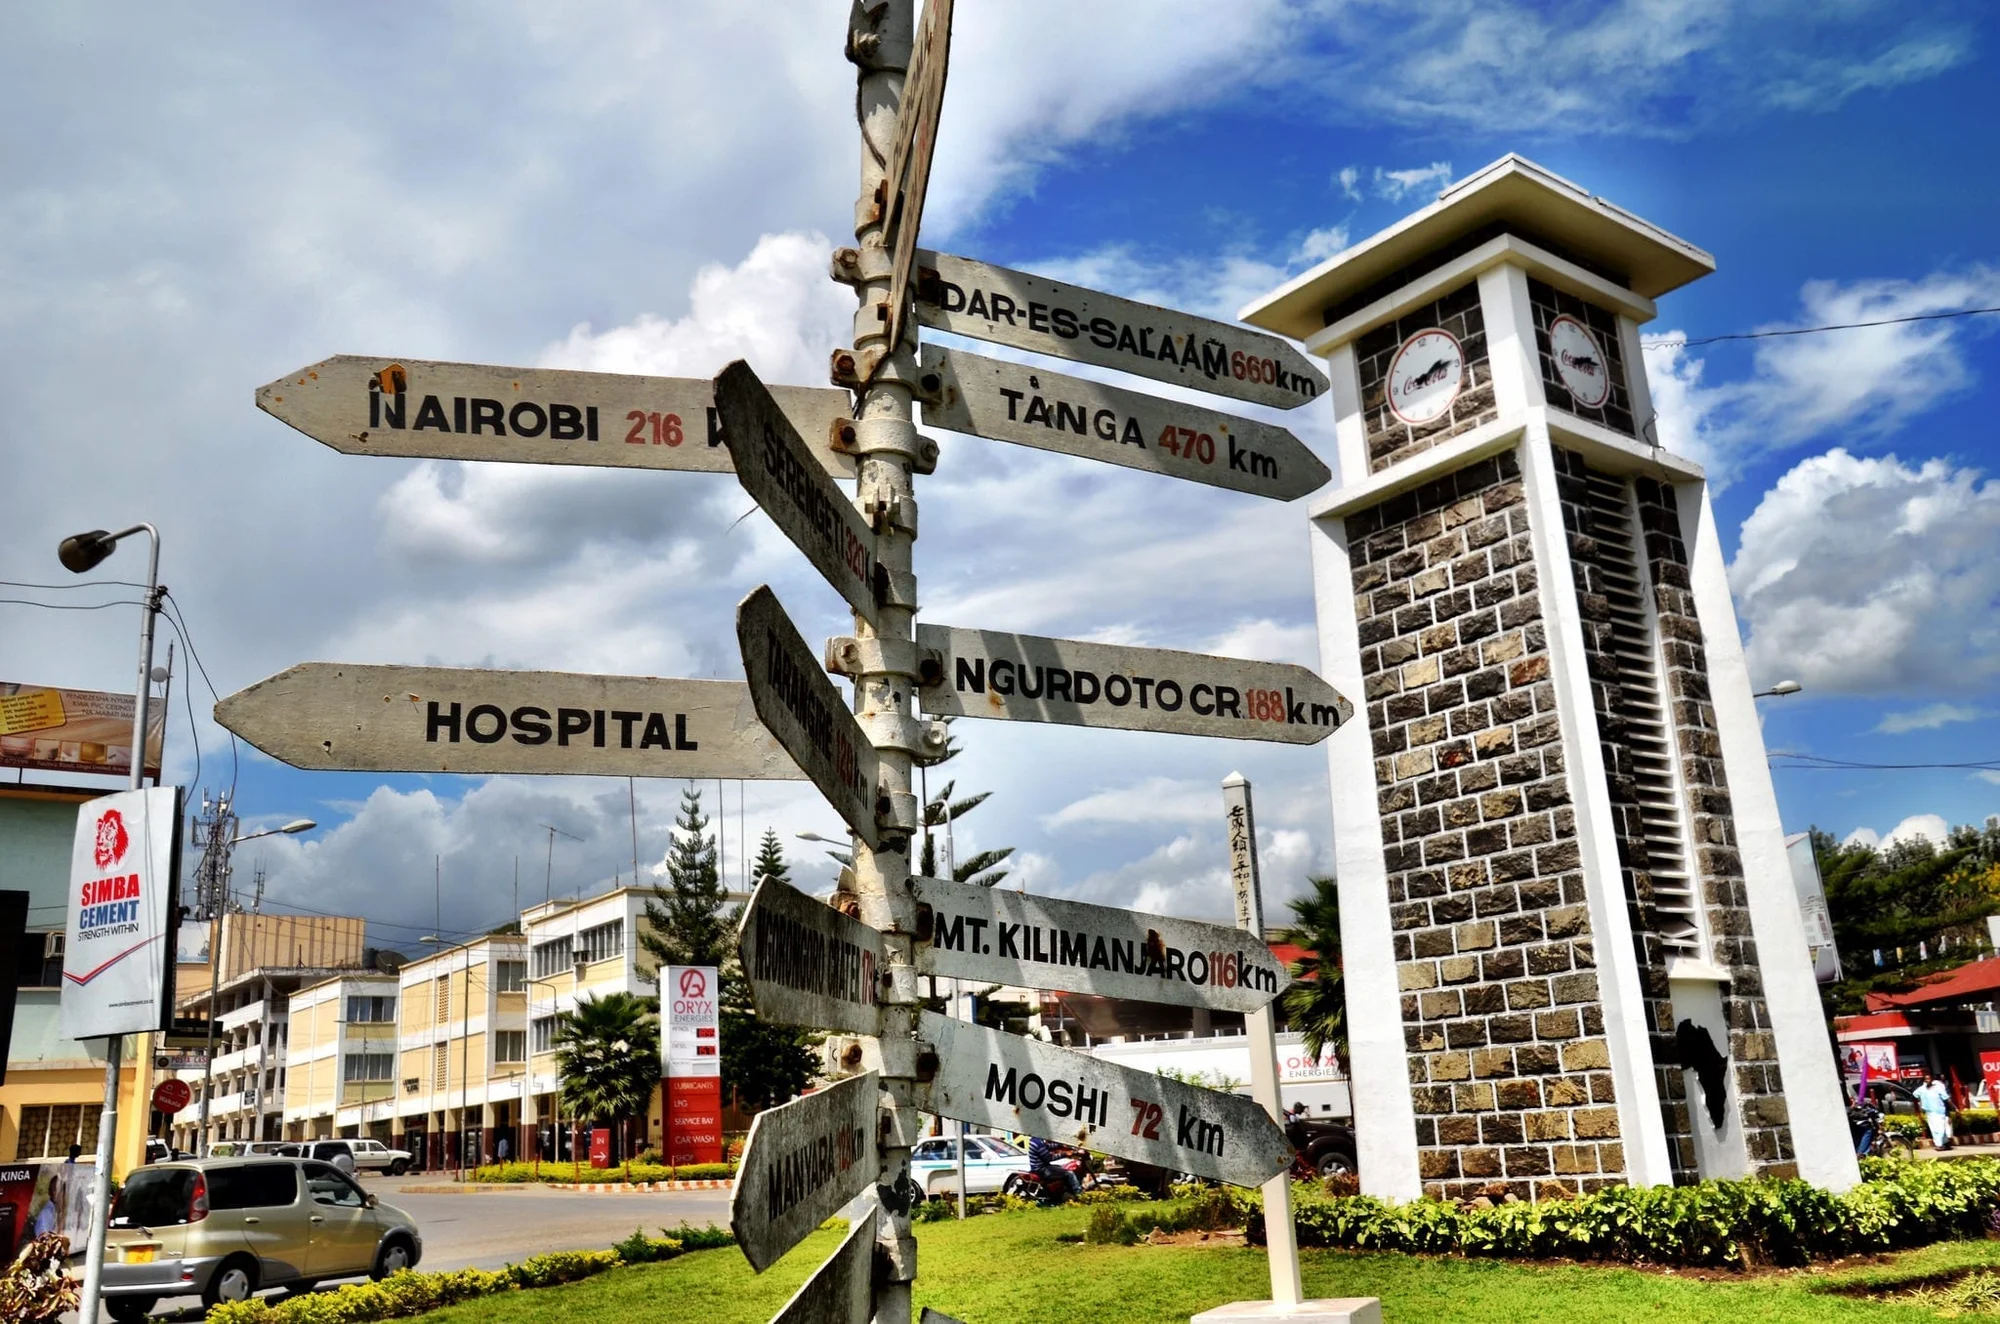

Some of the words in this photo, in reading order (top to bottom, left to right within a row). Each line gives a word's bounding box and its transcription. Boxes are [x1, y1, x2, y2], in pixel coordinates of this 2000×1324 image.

[940, 282, 1230, 378] DAR-ES-SALAAM
[1231, 350, 1276, 384] 660
[1276, 359, 1316, 397] km
[1418, 338, 1426, 347] 12
[369, 391, 598, 441] NAIROBI
[624, 410, 684, 447] 216
[1000, 387, 1146, 449] TANGA
[1158, 424, 1215, 465] 470
[1229, 434, 1278, 479] km
[763, 422, 844, 560] SERENGETI
[845, 526, 864, 582] 320
[767, 625, 833, 762] TARANGIRE
[956, 658, 1183, 712] NGURDOTO
[1286, 687, 1340, 727] km
[426, 701, 698, 751] HOSPITAL
[81, 873, 141, 907] SIMBA
[79, 899, 140, 930] CEMENT
[78, 925, 110, 942] STRENGTH
[111, 922, 139, 936] WITHIN
[755, 904, 824, 995] NGORONGORO
[933, 912, 990, 955] MT.
[999, 923, 1209, 986] KILIMANJARO
[1208, 951, 1237, 989] 116
[1237, 951, 1278, 994] km
[673, 1000, 713, 1014] ORYX
[674, 1014, 713, 1023] ENERGIES
[1287, 1055, 1336, 1069] ORX
[1289, 1068, 1337, 1077] ENERGIES
[673, 1081, 714, 1090] LUBRICANTS
[673, 1100, 688, 1108] LPG
[984, 1063, 1109, 1128] MOSHI
[1130, 1098, 1163, 1141] 72
[1177, 1104, 1224, 1157] km
[674, 1118, 700, 1126] SERVICE
[701, 1117, 714, 1125] BAY
[596, 1137, 605, 1145] IN
[674, 1136, 691, 1144] CAR
[692, 1135, 715, 1143] WASH
[1, 1170, 31, 1182] KINGA
[768, 1132, 836, 1222] MANYARA
[850, 1112, 864, 1164] km
